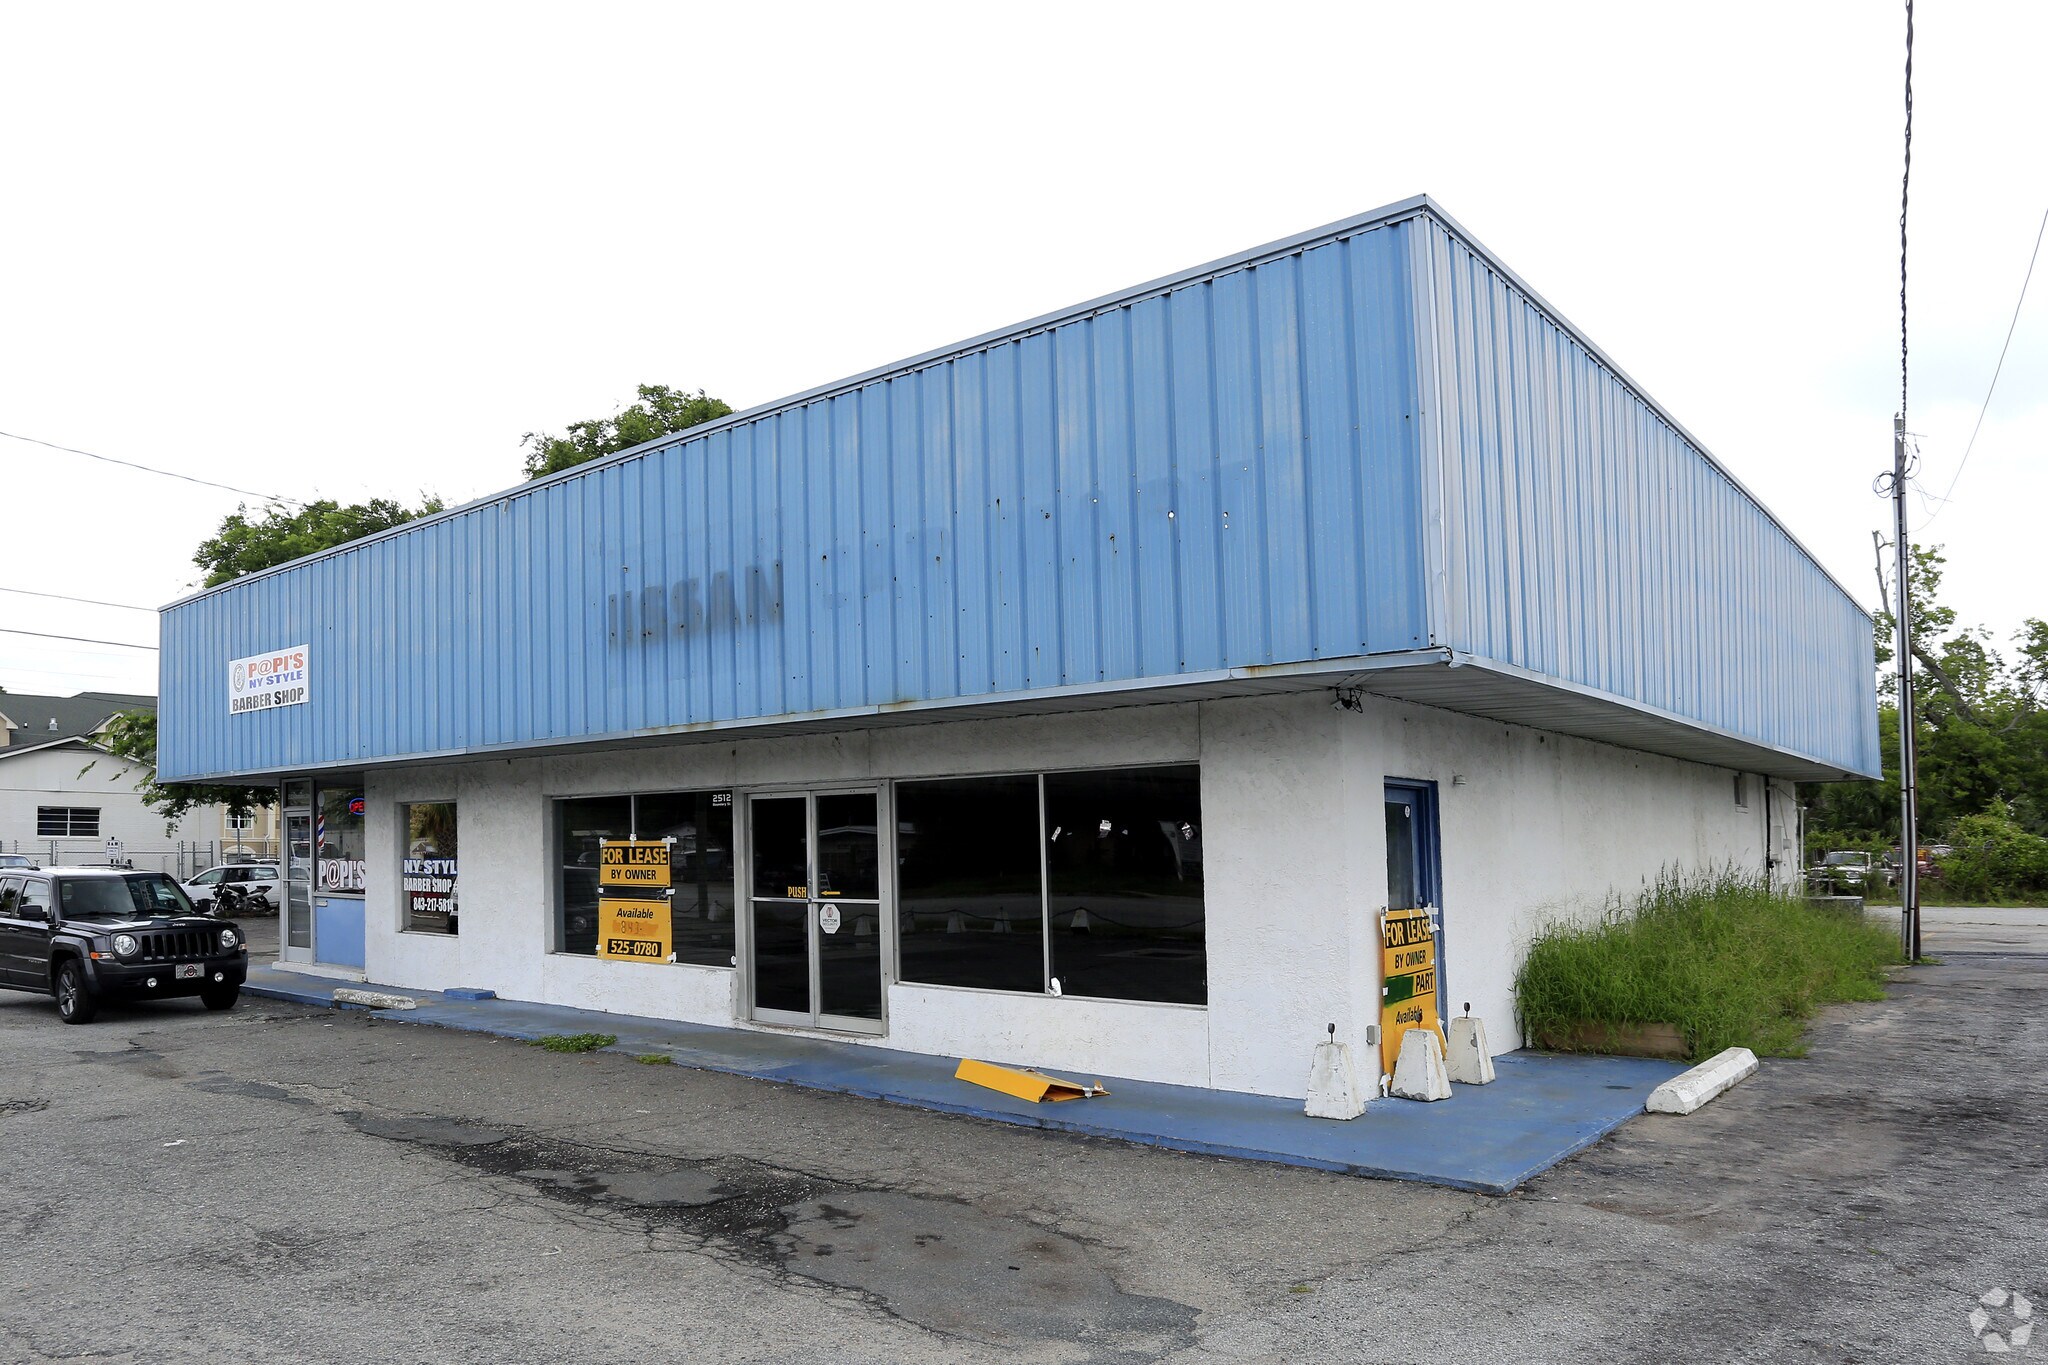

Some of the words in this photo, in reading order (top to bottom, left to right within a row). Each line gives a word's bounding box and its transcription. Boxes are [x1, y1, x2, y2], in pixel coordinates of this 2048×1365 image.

[248, 652, 304, 678] P@PI'S
[249, 678, 263, 689] NY
[266, 670, 303, 686] STYLE
[232, 692, 272, 712] BARBER
[274, 687, 304, 705] SHOP
[712, 794, 731, 802] 2512
[350, 801, 365, 812] OPE
[602, 848, 623, 864] FOR
[629, 848, 668, 864] LEASE
[318, 860, 365, 889] P@PI'S
[403, 859, 421, 874] NY
[423, 859, 458, 875] STYL
[611, 869, 622, 879] BY
[625, 869, 656, 880] OWNER
[403, 877, 431, 892] BARBER
[432, 878, 452, 893] SHOP
[787, 886, 807, 898] PUSH
[616, 907, 654, 919] Available
[1385, 922, 1405, 947] FOR
[1406, 919, 1432, 943] LEASE
[610, 940, 658, 956] 525-0780
[1394, 953, 1404, 969] BY
[1406, 949, 1427, 966] OWNER
[1415, 971, 1434, 993] PART
